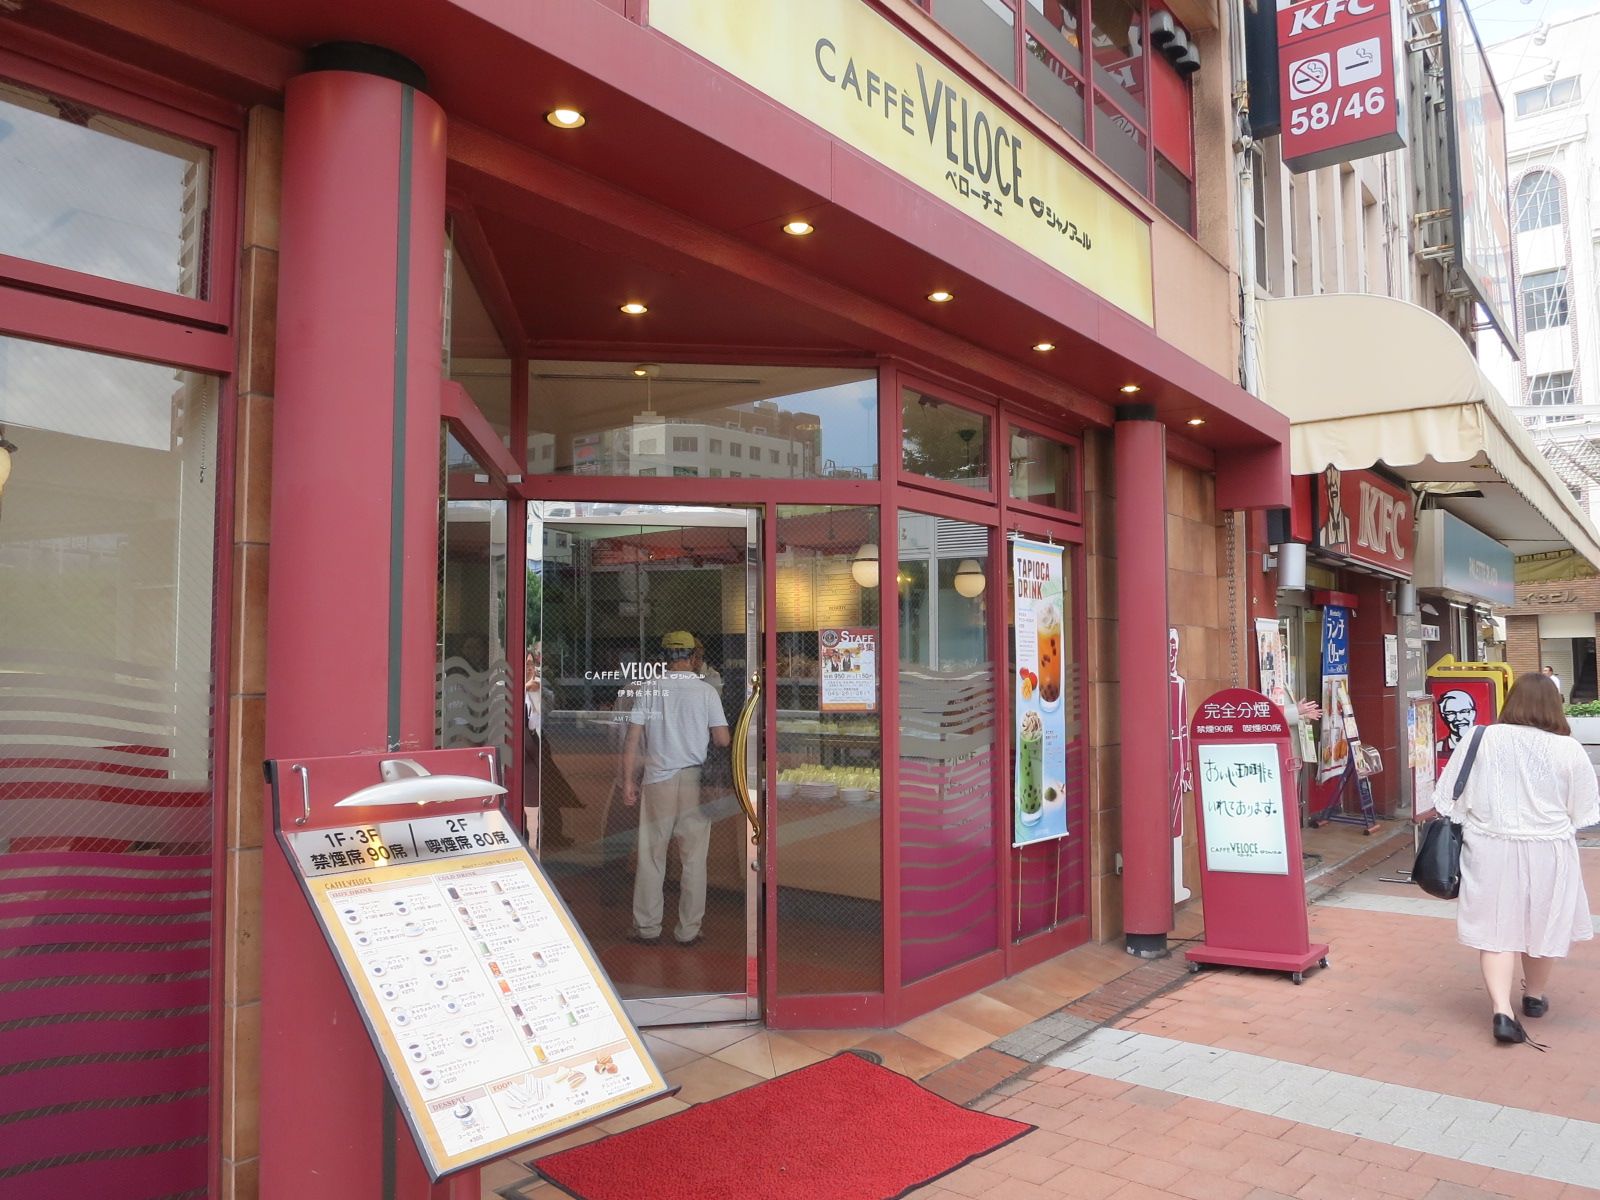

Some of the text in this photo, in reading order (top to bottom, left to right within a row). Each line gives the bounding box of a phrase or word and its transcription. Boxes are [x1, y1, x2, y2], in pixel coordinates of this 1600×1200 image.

[1289, 0, 1375, 37] KFC
[1290, 86, 1386, 136] 58/46
[815, 38, 1023, 208] CAFFÈ VELOCE
[945, 170, 1003, 217] ベローチェ
[1357, 480, 1406, 561] KFC
[1017, 558, 1050, 581] TAPIOCA
[1018, 579, 1043, 600] DRINK
[841, 631, 873, 642] STAFF
[620, 662, 668, 680] VELOCE
[1204, 703, 1270, 719] 完全分煙
[446, 818, 468, 833] 2F
[425, 831, 509, 854] 喫煙席 80席
[1230, 842, 1258, 854] VELOCE
[311, 843, 408, 870] 禁煙席 90席
